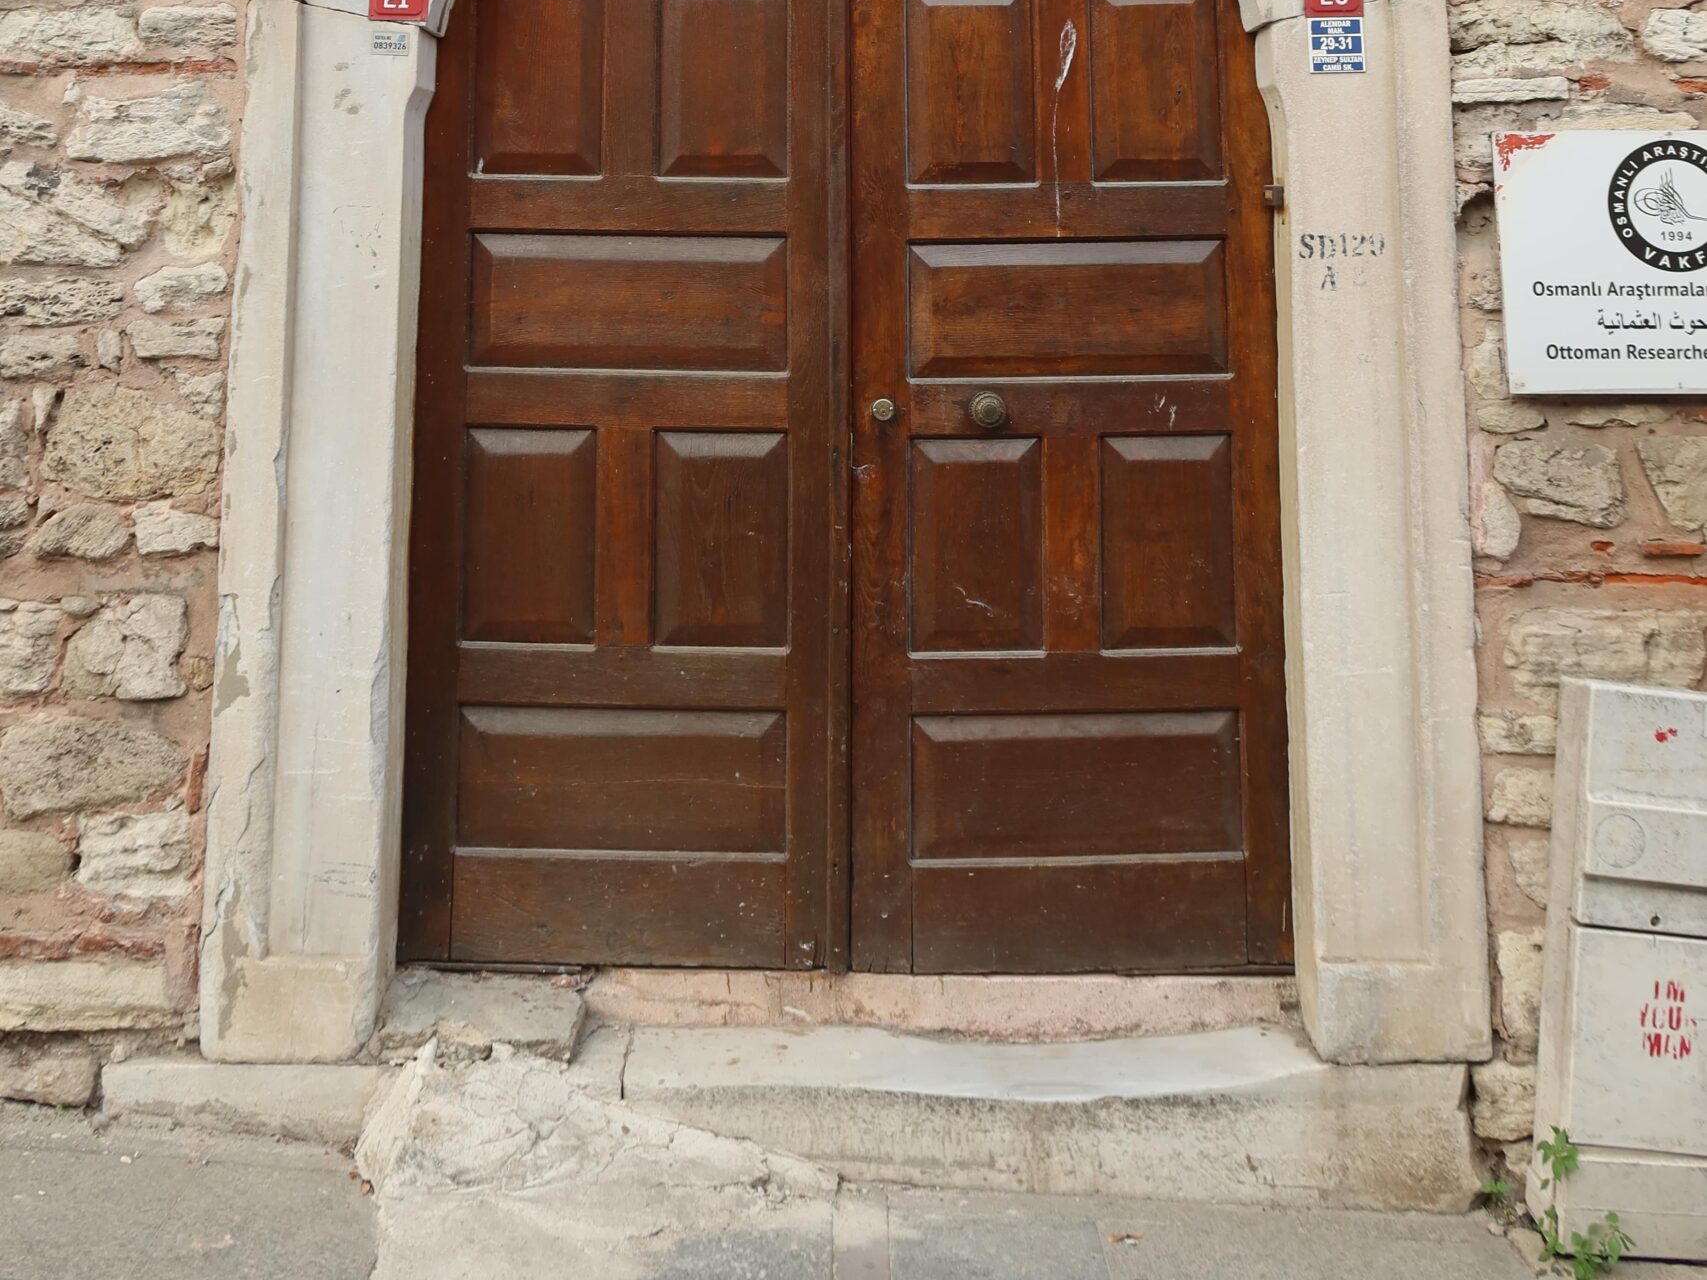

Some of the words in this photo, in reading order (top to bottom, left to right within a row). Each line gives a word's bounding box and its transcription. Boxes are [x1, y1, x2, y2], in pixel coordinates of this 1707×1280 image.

[1320, 20, 1351, 28] ALEMDAR
[373, 41, 407, 50] 0839326
[1320, 36, 1353, 50] 29-31
[1313, 56, 1338, 64] ZEYNEP
[1613, 160, 1639, 239] OSMANLI
[1642, 145, 1707, 168] ARAŞTI
[1660, 231, 1693, 241] 1994
[1532, 281, 1601, 297] Osmanlı
[1607, 281, 1707, 300] Araştırmala
[1546, 343, 1621, 360] Ottoman
